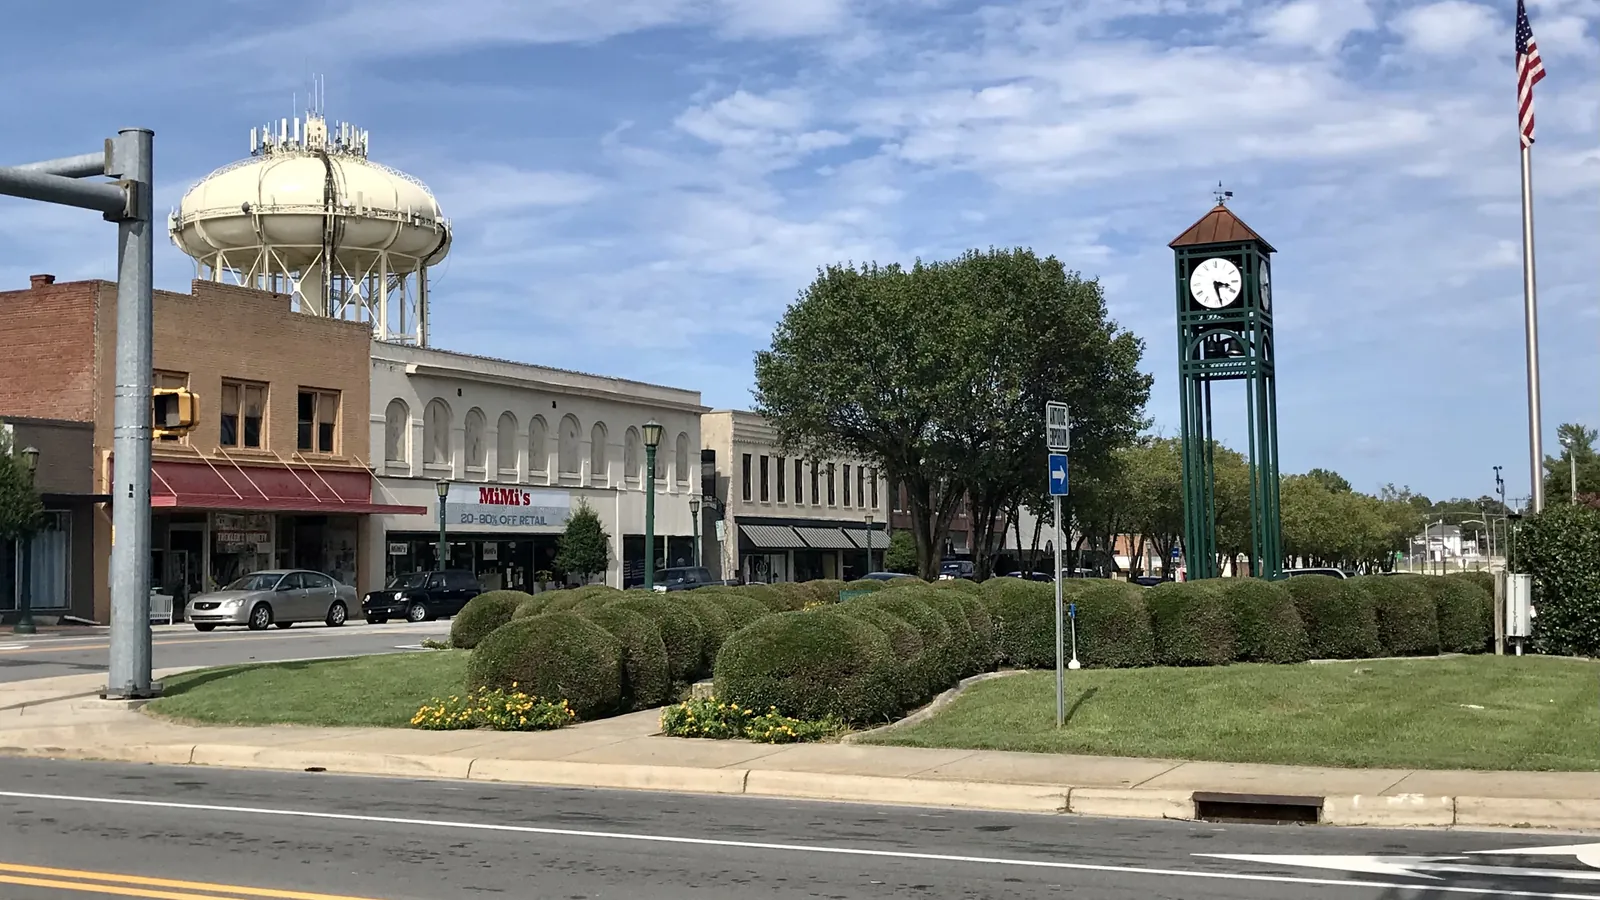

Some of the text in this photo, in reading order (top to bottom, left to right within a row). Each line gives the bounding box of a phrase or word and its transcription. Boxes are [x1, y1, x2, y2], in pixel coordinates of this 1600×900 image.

[479, 487, 531, 506] MiMi's
[460, 513, 547, 526] 20-80% OFF RETAIL
